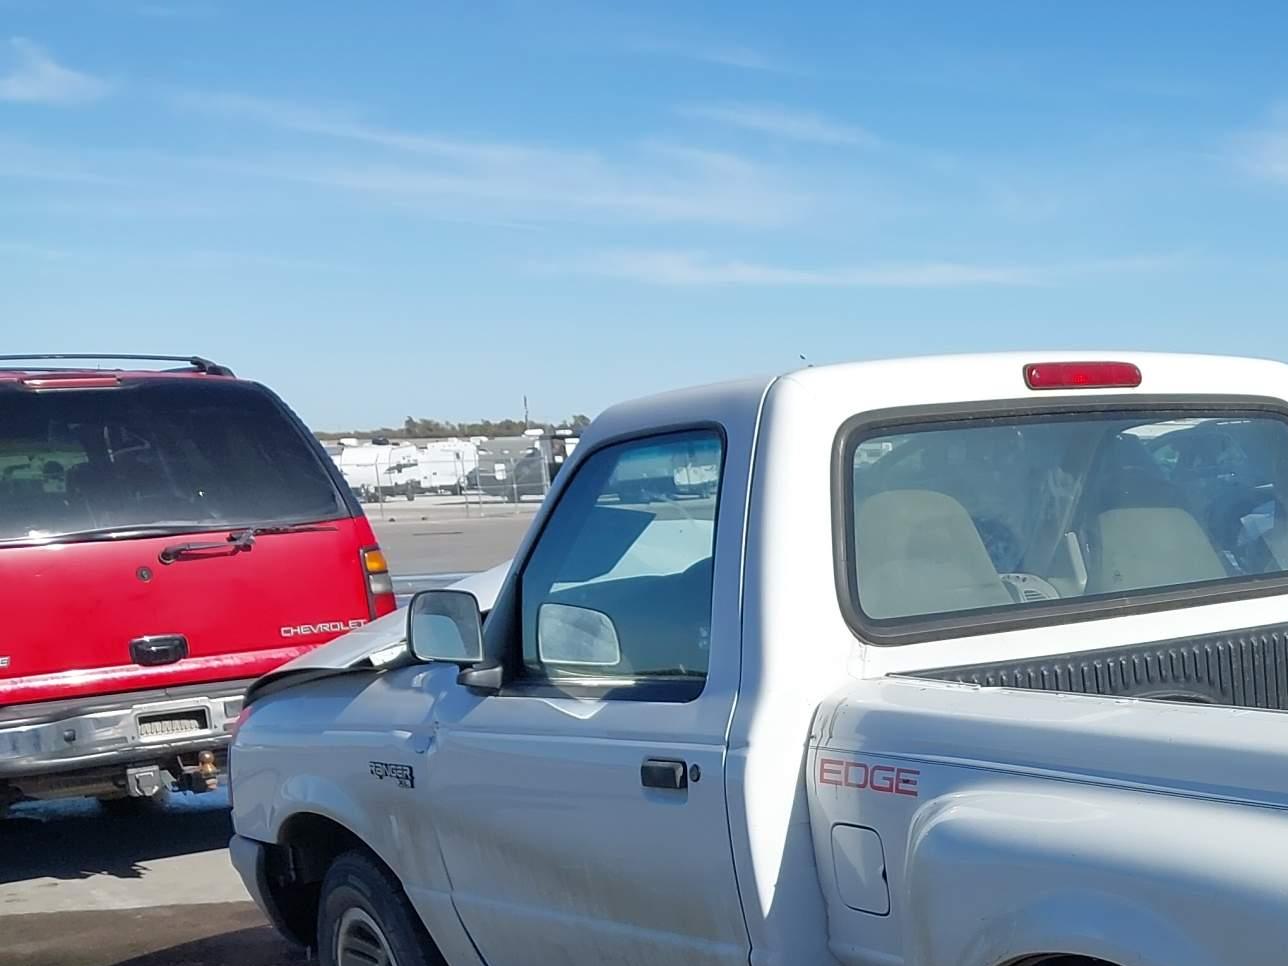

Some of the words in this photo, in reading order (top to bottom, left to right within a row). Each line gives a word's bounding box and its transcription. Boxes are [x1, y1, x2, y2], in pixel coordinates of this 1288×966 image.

[281, 619, 367, 637] CHEVROLET
[368, 762, 411, 780] RANGER
[819, 757, 921, 798] EDGE
